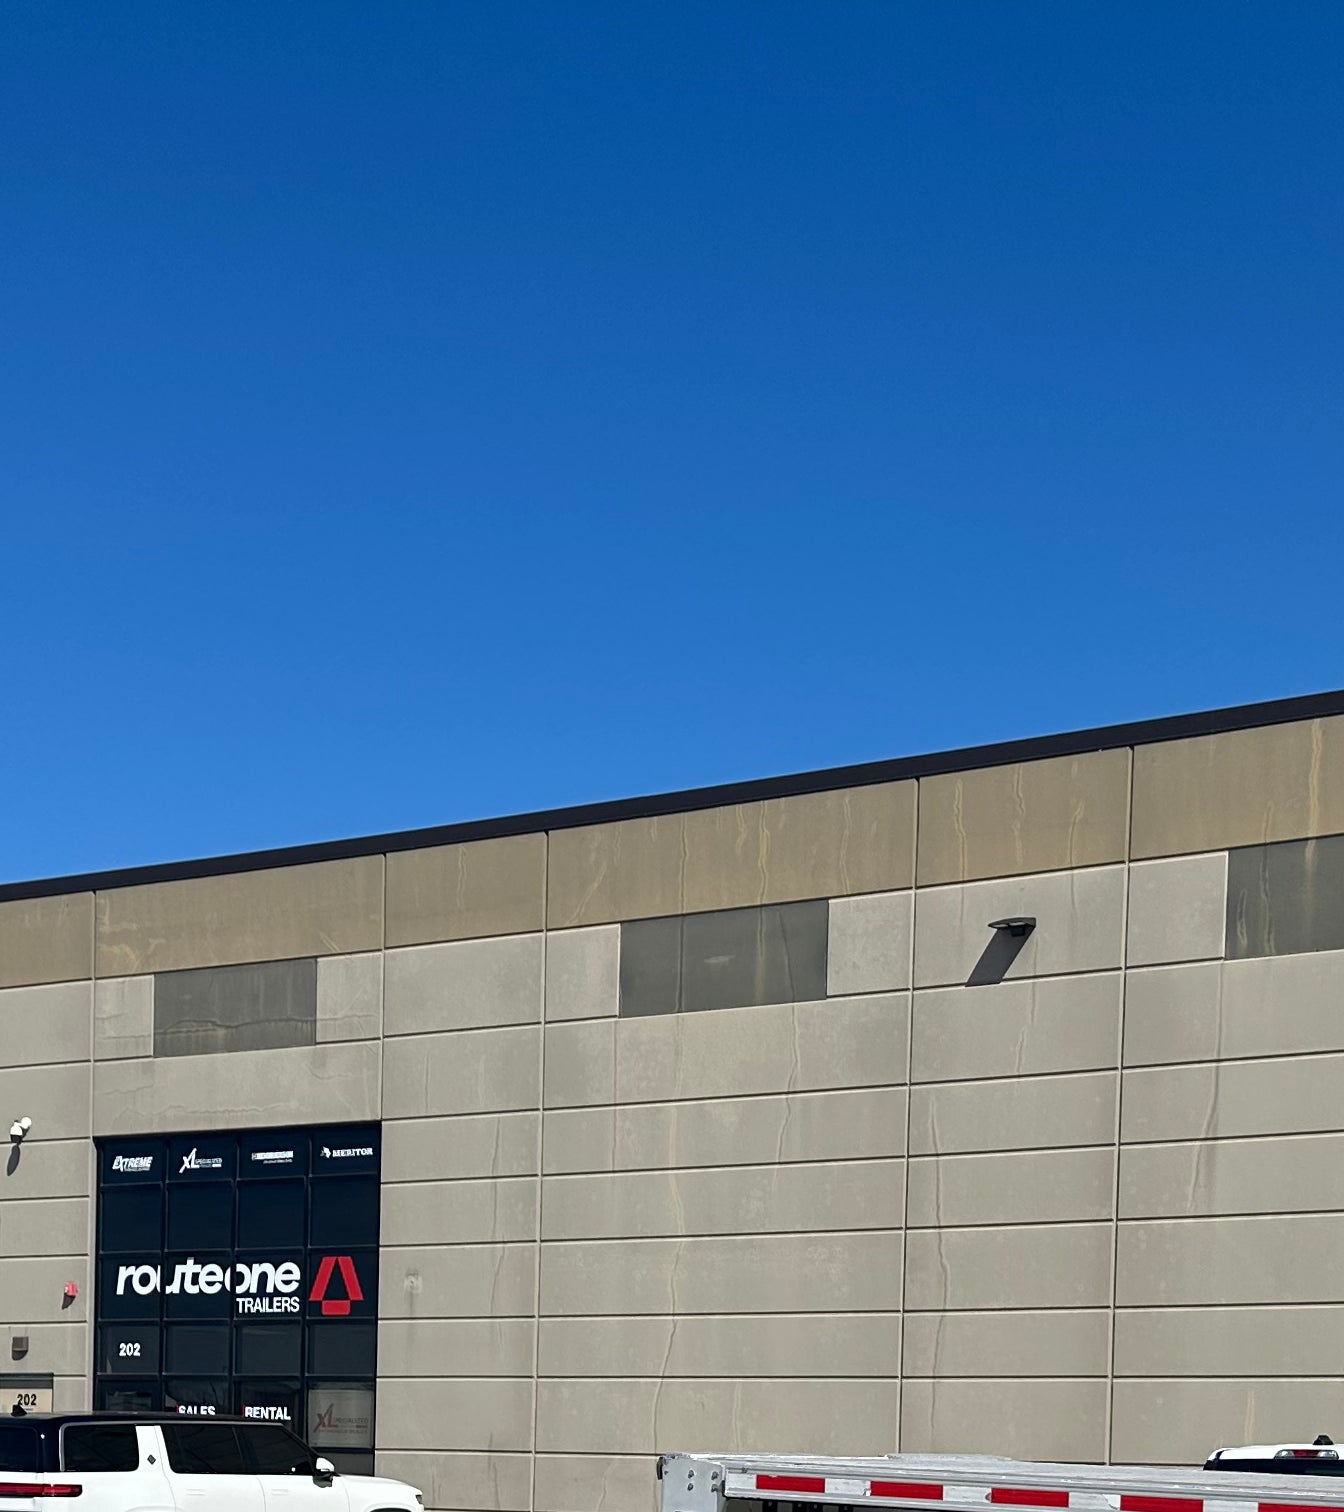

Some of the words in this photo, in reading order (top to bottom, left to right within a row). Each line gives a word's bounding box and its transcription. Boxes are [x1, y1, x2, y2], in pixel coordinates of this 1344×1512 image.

[332, 1147, 373, 1159] MERITOR
[116, 1256, 301, 1296] routeone
[235, 1296, 301, 1314] TRAILERS
[118, 1342, 142, 1358] 202
[16, 1393, 37, 1406] 202
[244, 1406, 291, 1420] RENTAL
